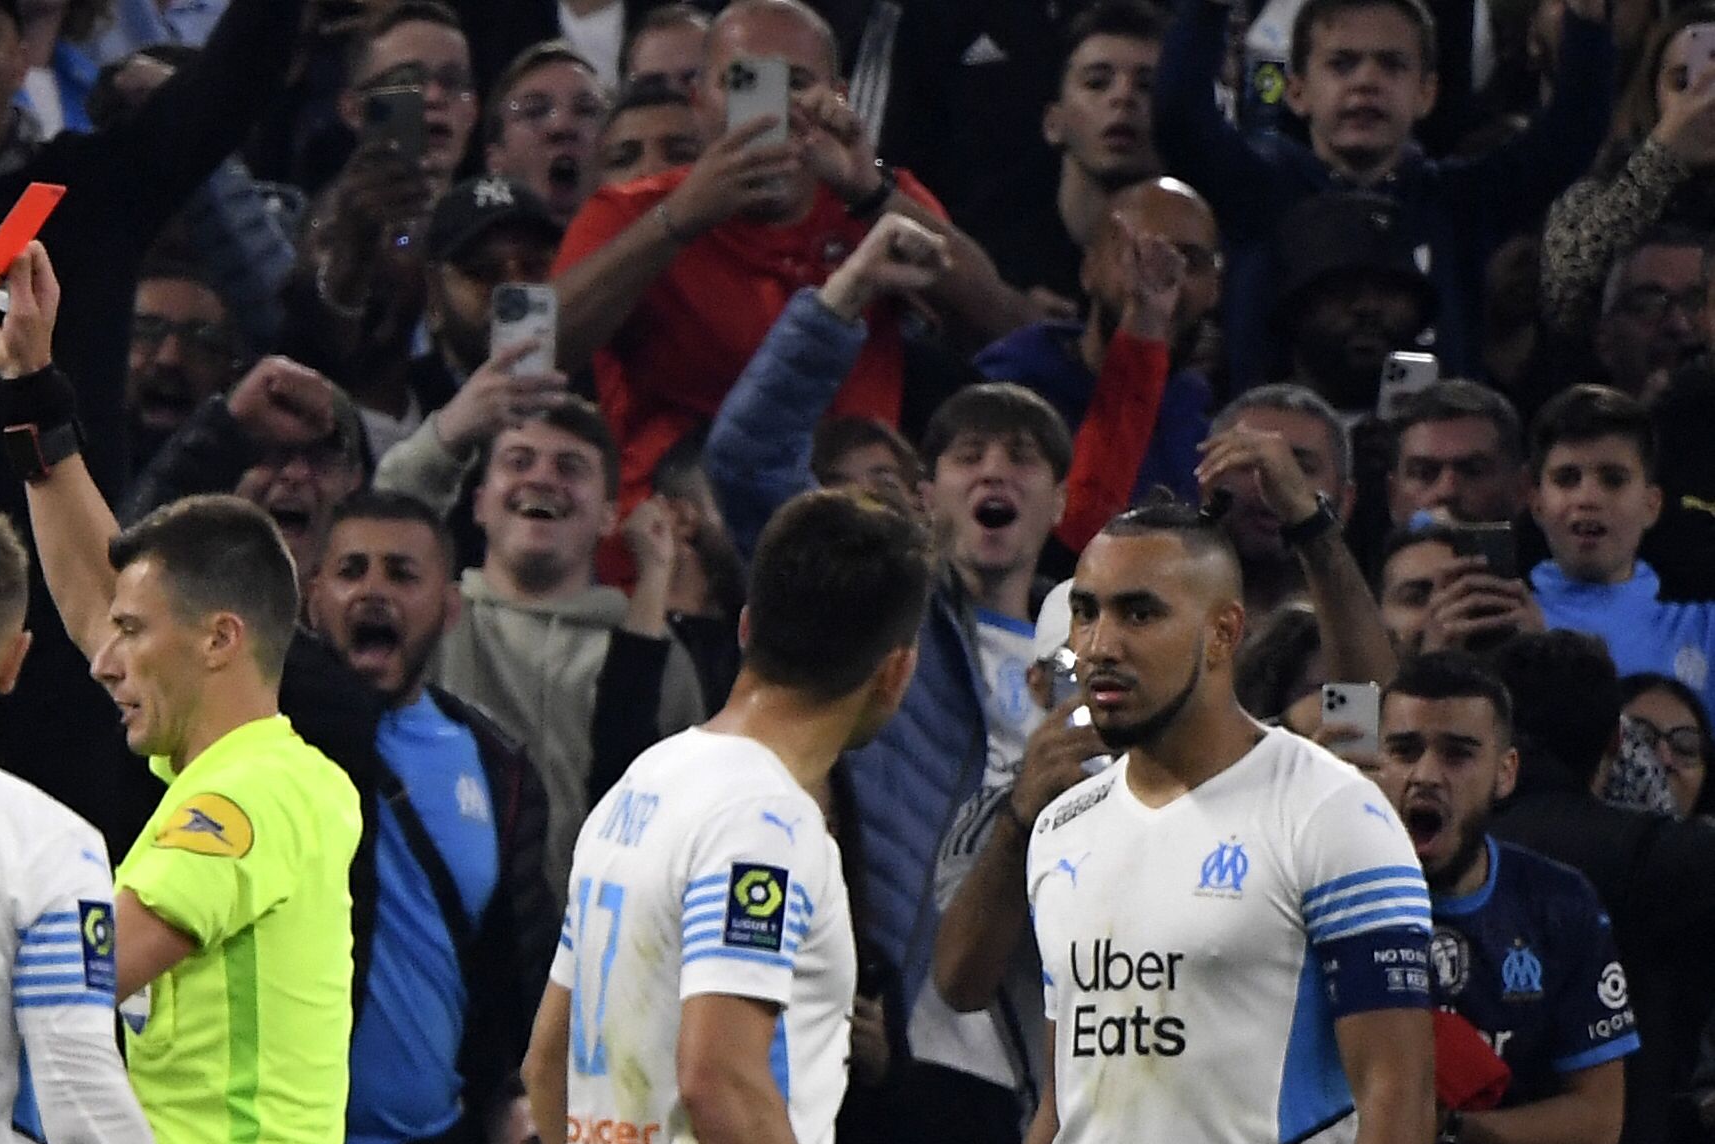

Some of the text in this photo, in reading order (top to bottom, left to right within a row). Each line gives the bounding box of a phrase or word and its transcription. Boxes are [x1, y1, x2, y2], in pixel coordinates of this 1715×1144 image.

[571, 876, 624, 1077] 17
[1070, 937, 1184, 993] Uber
[1072, 1003, 1186, 1057] Eats
